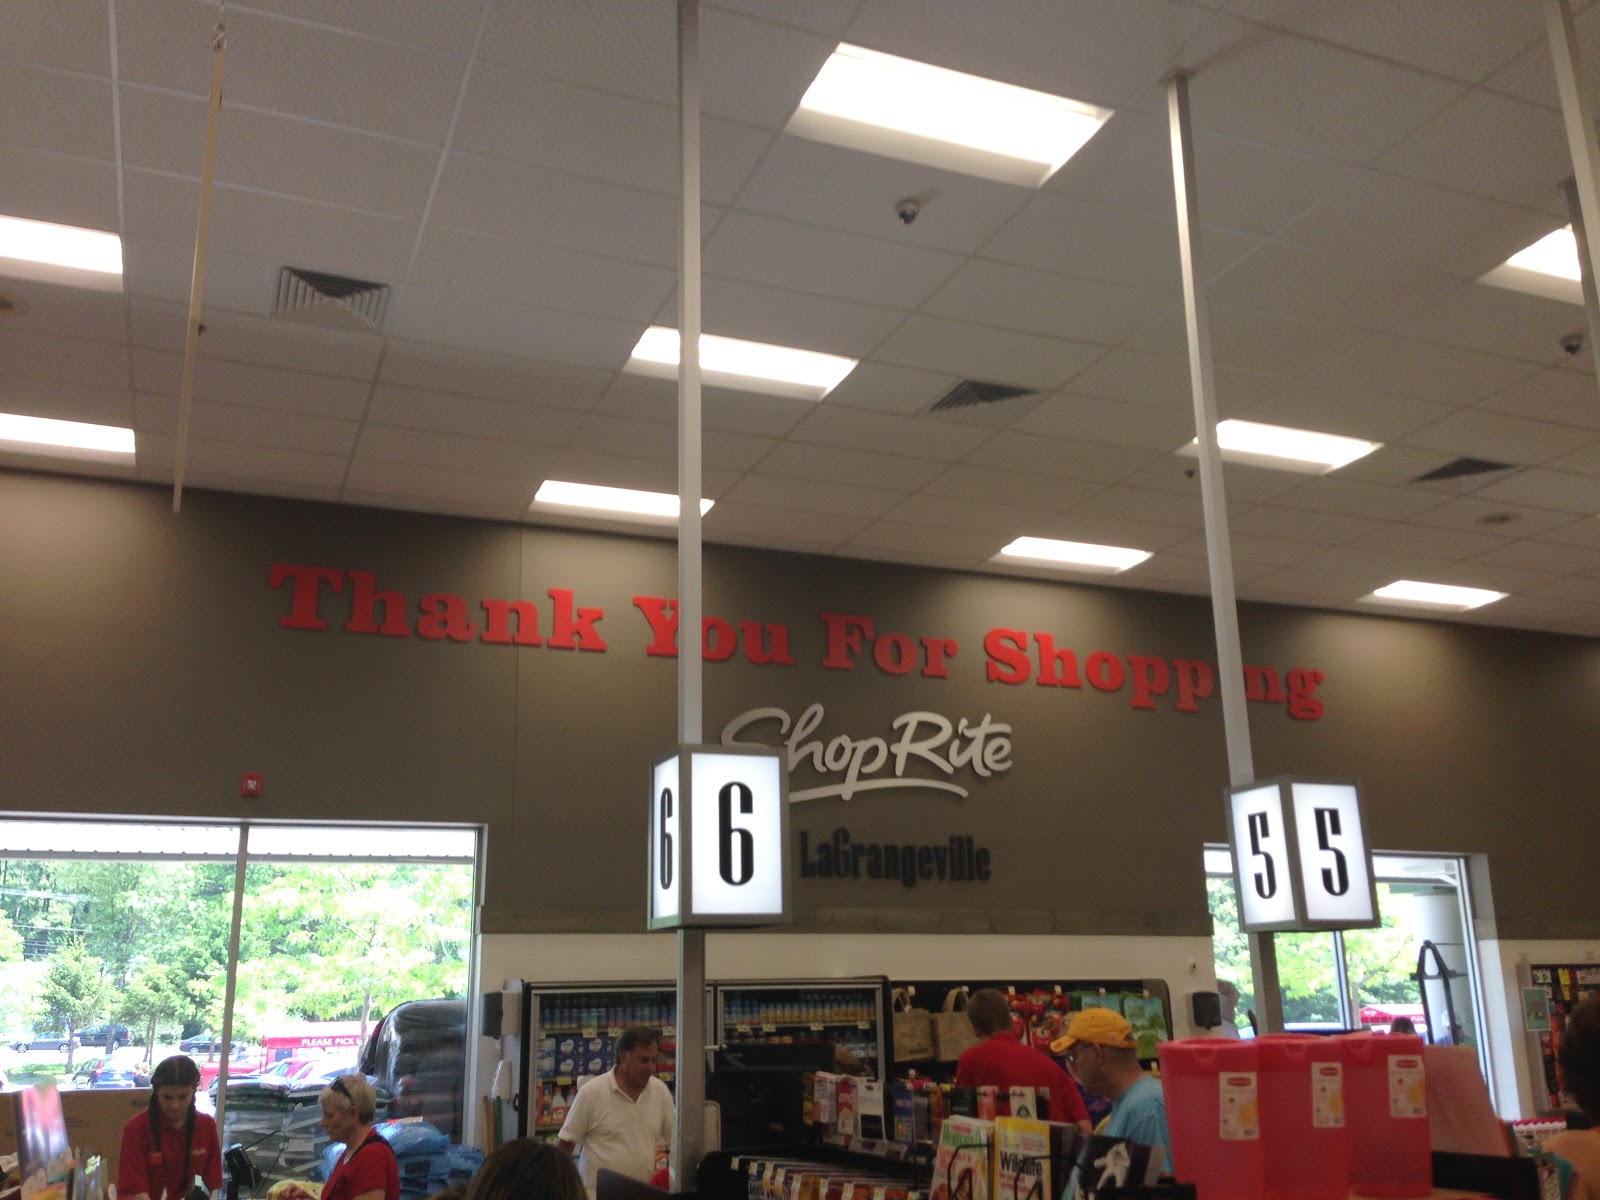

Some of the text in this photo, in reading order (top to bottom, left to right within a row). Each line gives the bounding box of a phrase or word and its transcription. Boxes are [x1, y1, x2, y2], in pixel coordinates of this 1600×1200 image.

[270, 562, 1326, 720] Thank You For Shoppng
[659, 786, 674, 891] 6
[718, 780, 755, 887] 6
[799, 827, 993, 888] LaGrangeville
[1246, 810, 1278, 900] 5
[1313, 807, 1351, 897] 5
[301, 1038, 333, 1047] PLEASE
[334, 1037, 355, 1046] PICK
